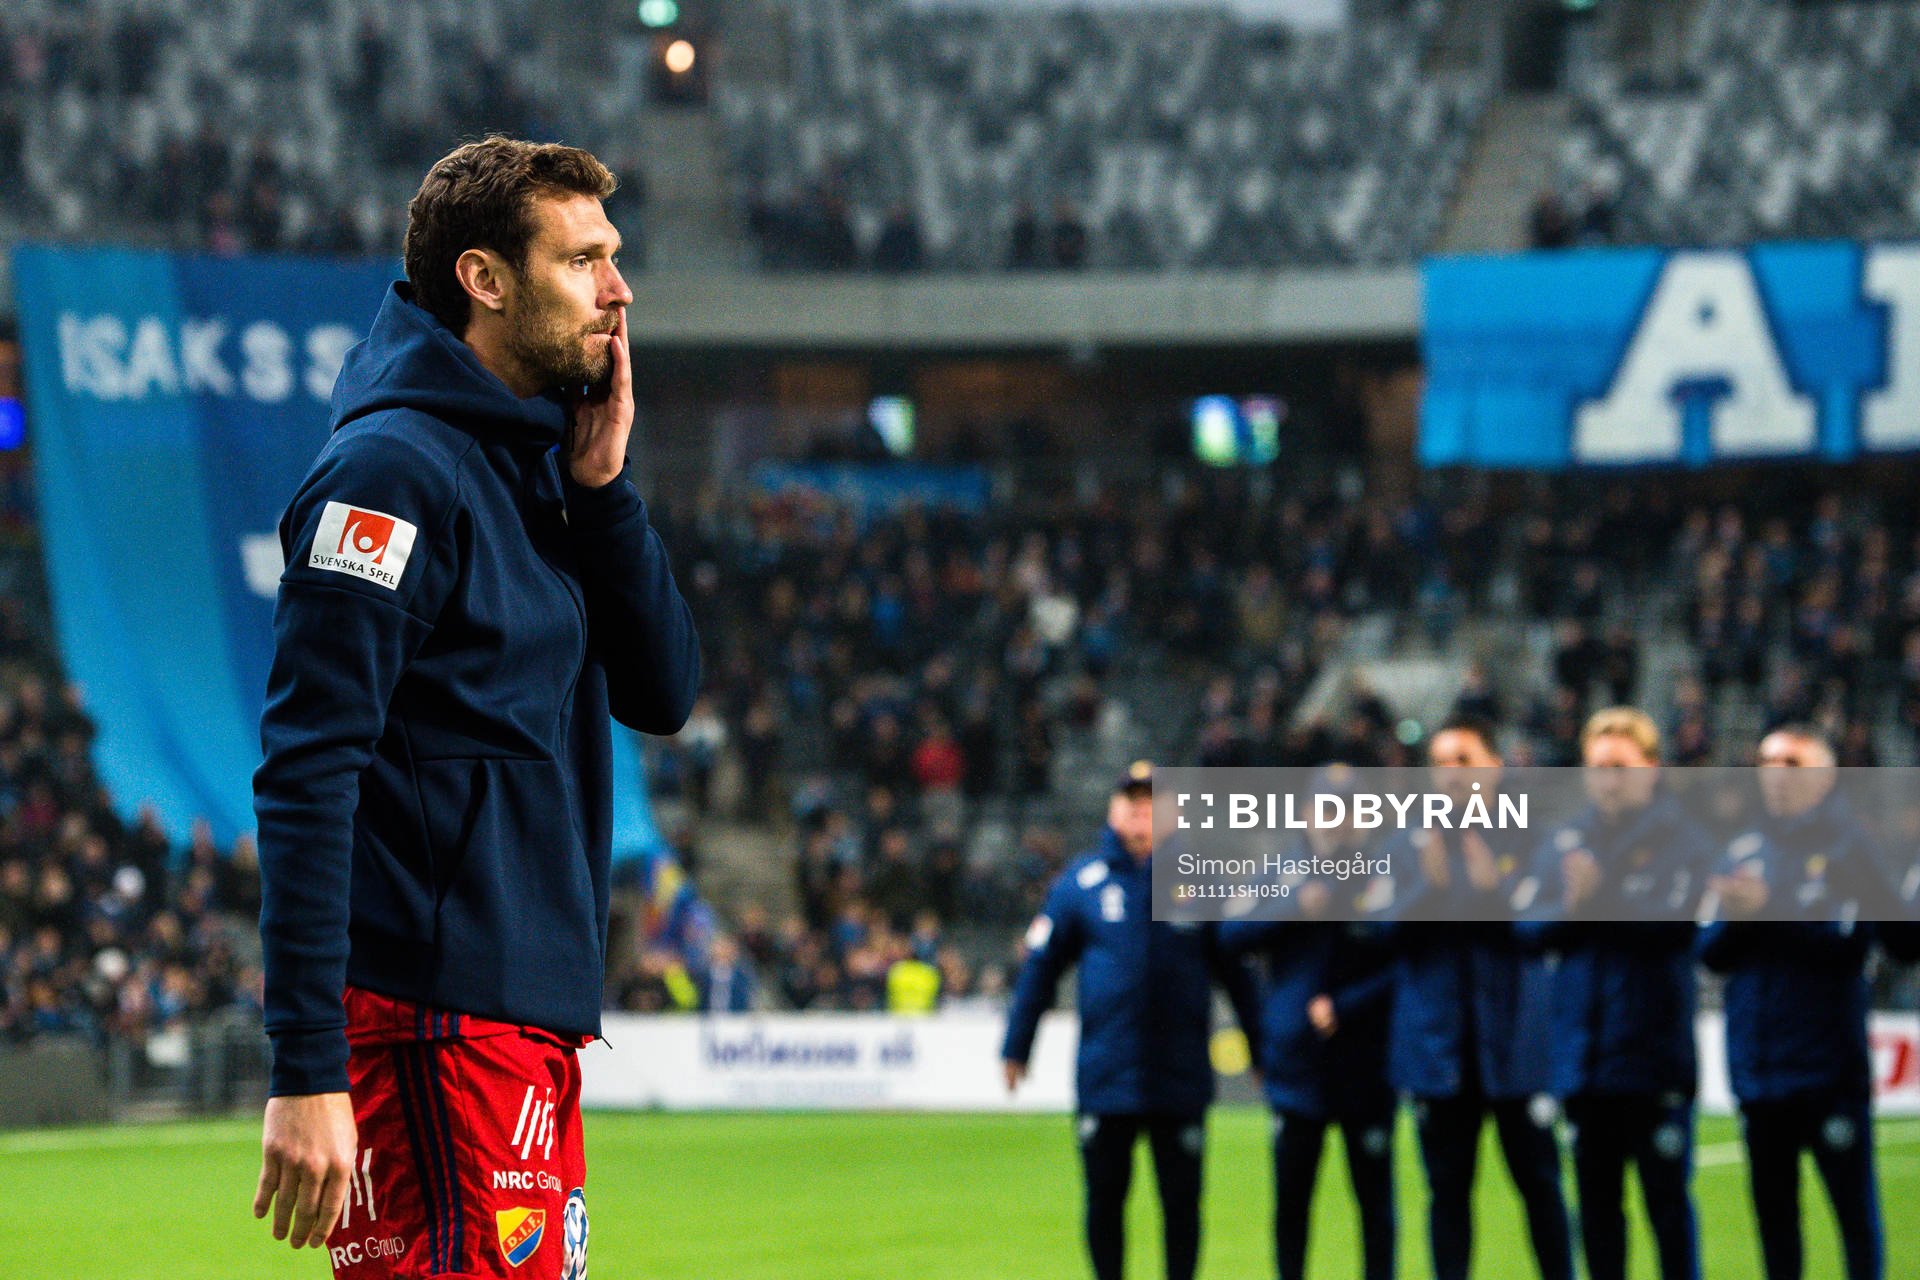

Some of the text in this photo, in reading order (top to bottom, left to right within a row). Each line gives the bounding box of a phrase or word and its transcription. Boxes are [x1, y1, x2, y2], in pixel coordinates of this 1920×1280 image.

[312, 554, 395, 585] SVENSKA SPEL
[493, 1170, 534, 1190] NRC
[330, 1242, 363, 1270] RC
